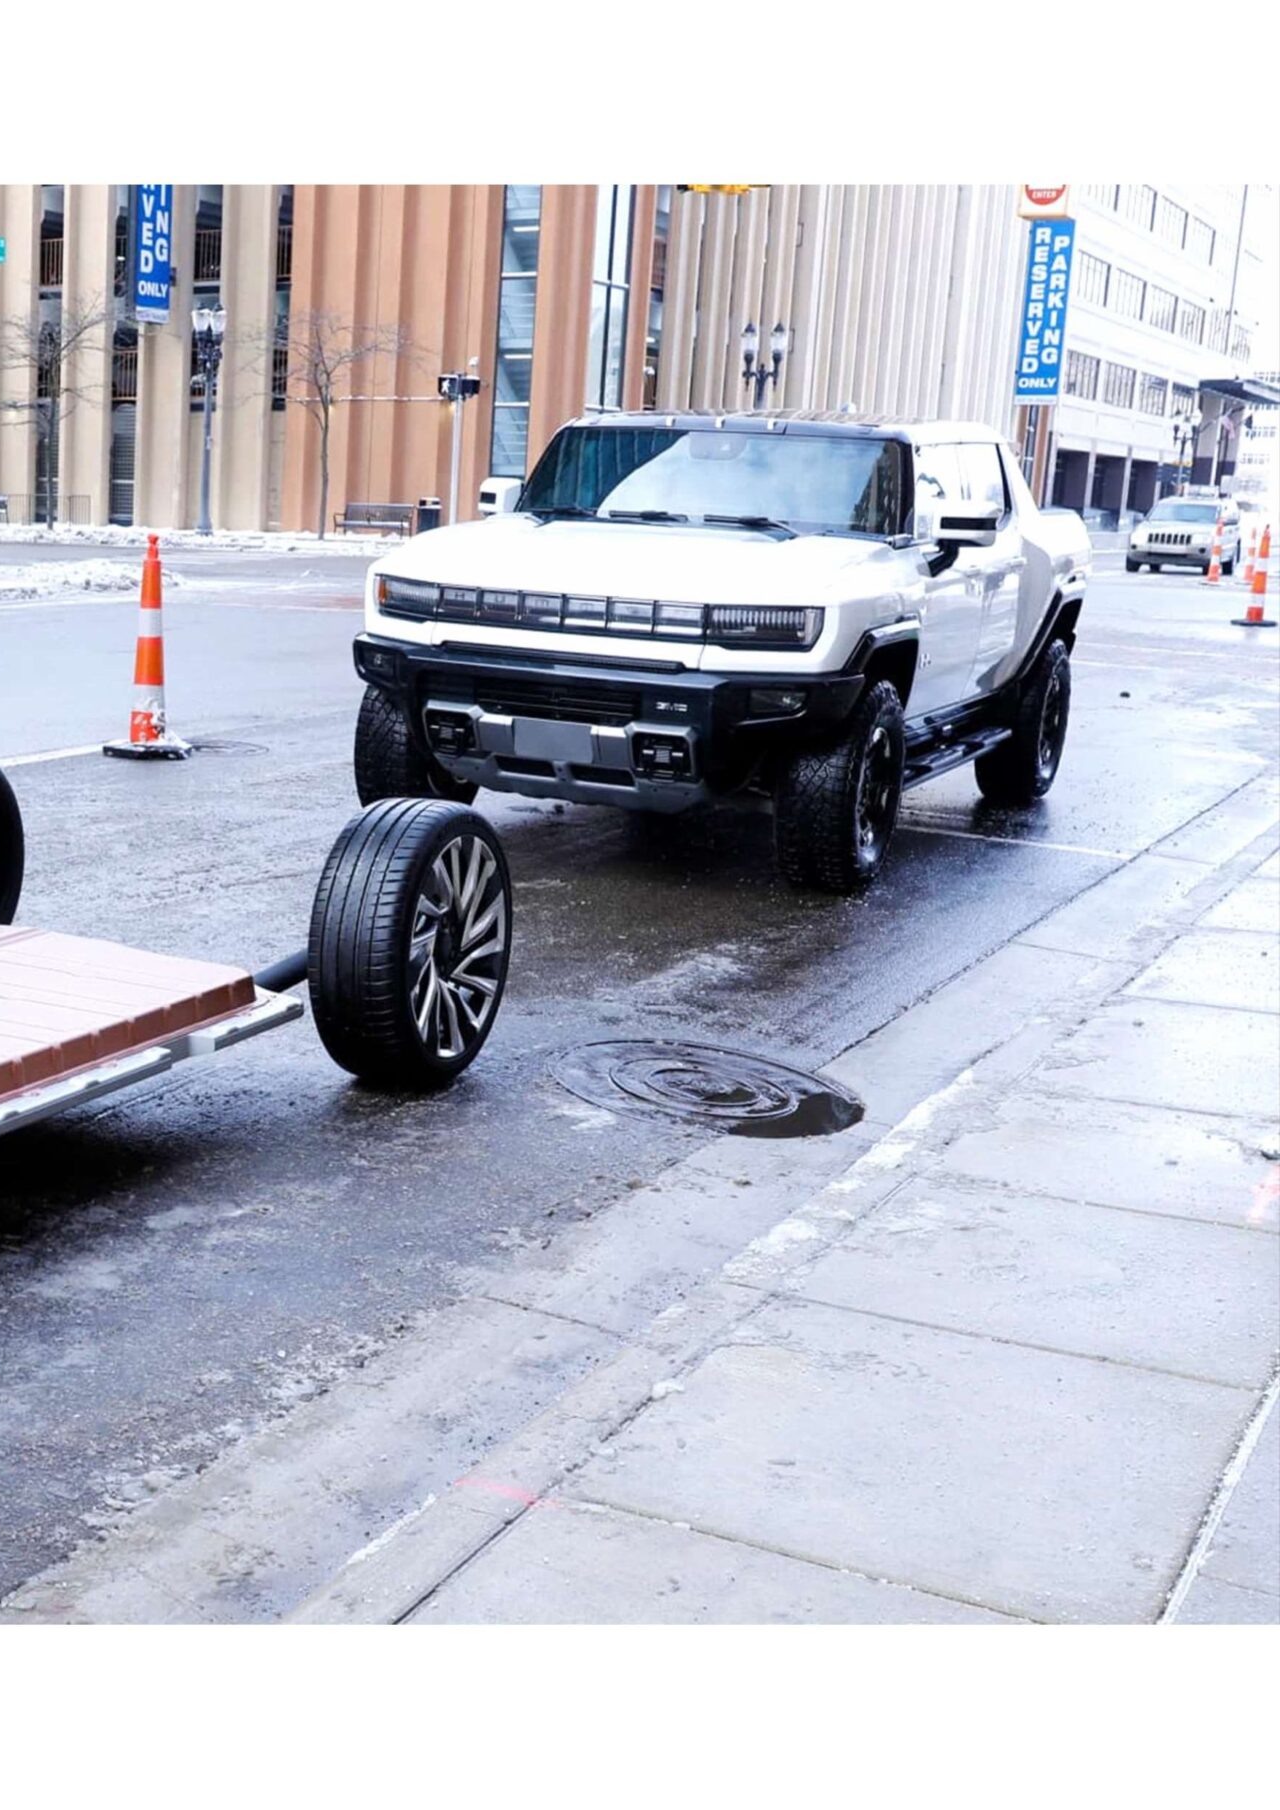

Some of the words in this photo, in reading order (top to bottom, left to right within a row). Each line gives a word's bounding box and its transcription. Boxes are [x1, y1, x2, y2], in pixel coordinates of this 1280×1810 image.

[138, 280, 169, 298] ONLY
[1022, 227, 1052, 373] RESERVED
[1040, 235, 1071, 364] PARKING
[1018, 377, 1057, 389] ONLY
